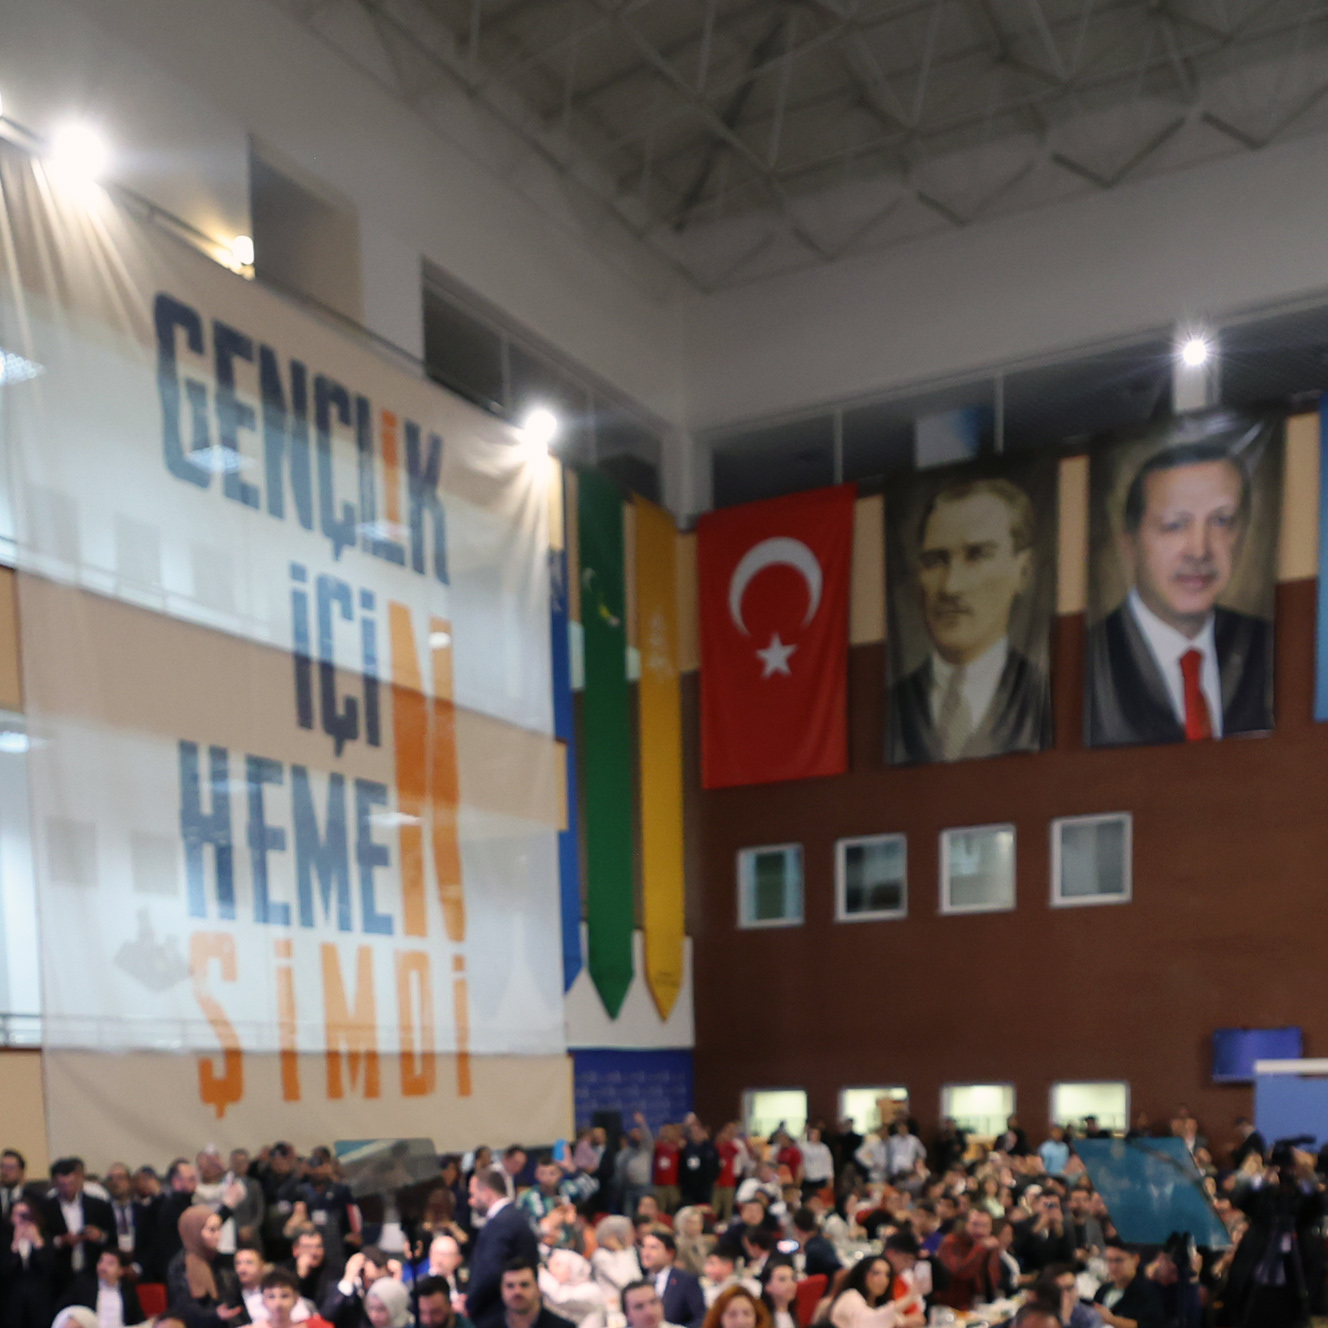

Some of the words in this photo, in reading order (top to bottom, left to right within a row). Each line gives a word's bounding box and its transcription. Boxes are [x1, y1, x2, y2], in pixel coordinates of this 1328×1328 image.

[154, 291, 449, 586] GENÇLİK
[178, 738, 467, 944] HEMEN
[188, 931, 471, 1120] ŞİMDİ
